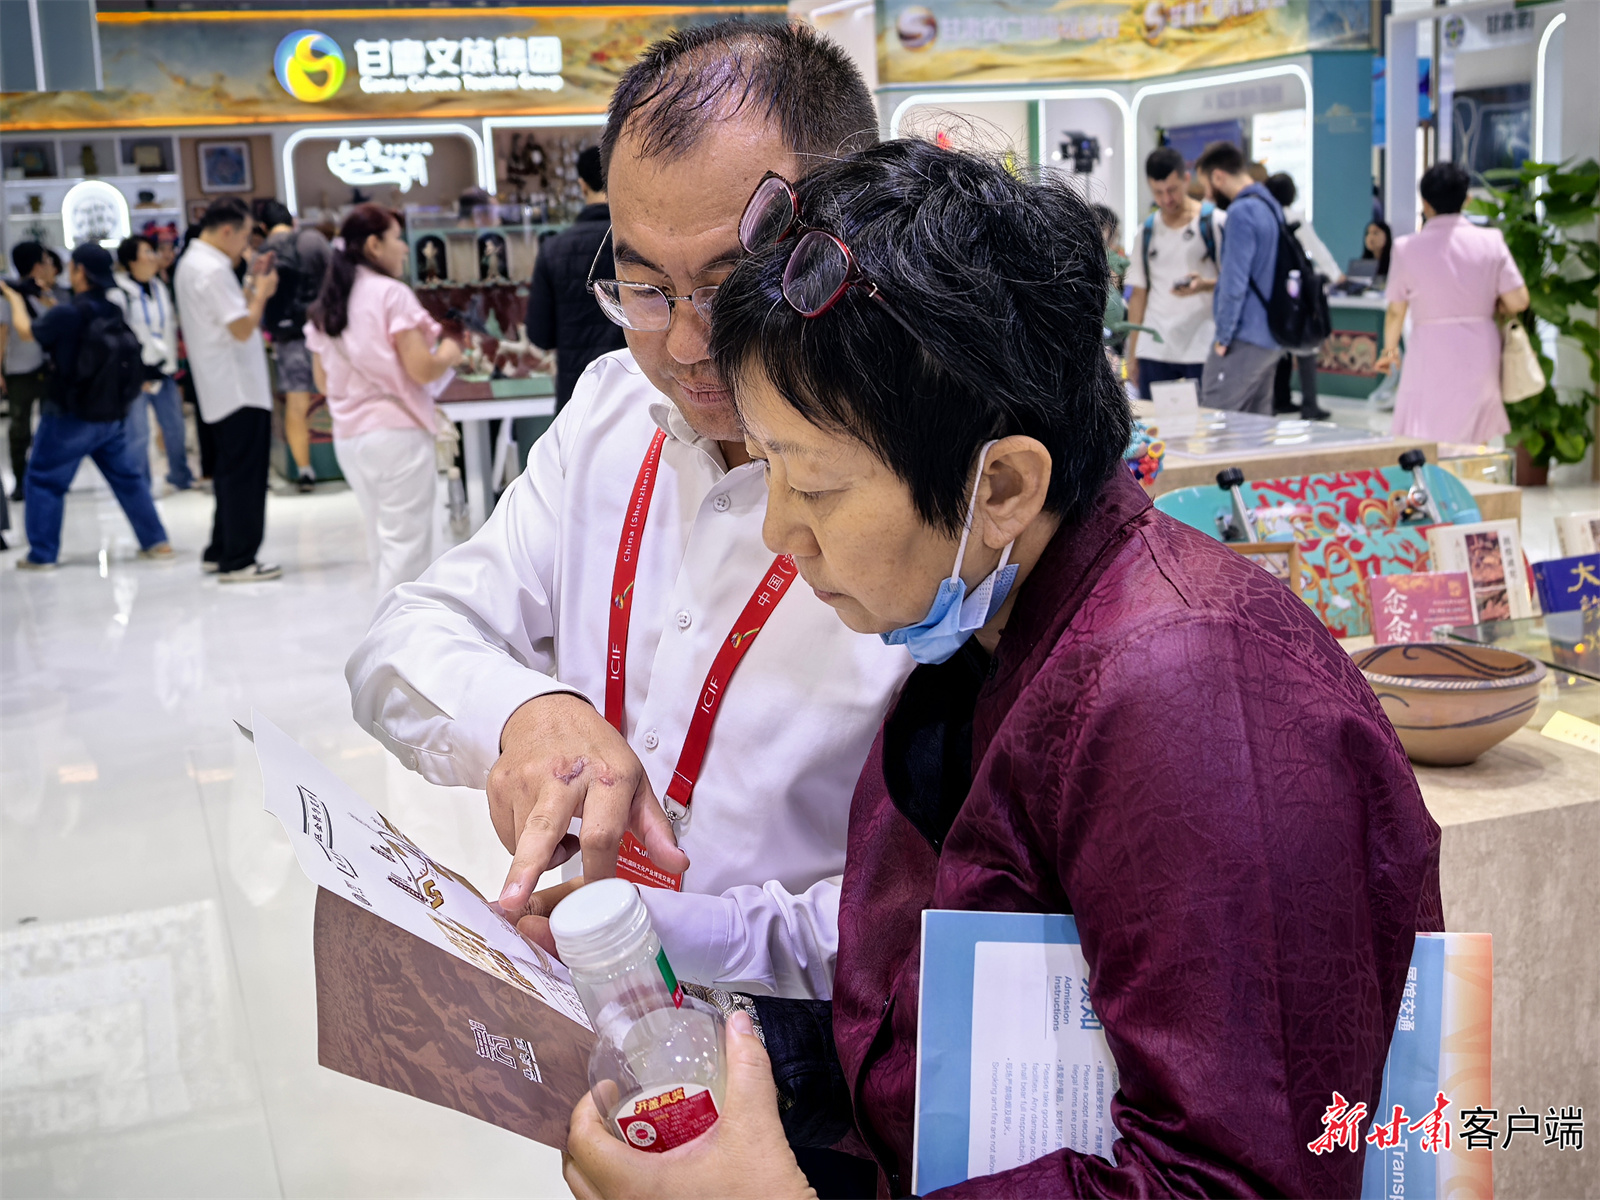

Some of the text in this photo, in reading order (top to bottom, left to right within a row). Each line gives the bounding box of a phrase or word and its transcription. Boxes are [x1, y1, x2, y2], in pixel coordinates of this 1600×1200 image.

[622, 530, 631, 562] China
[630, 467, 652, 530] (Shenzhen)
[609, 643, 620, 680] ICIF
[701, 675, 719, 714] ICIF
[1053, 975, 1062, 1031] Instructions
[1063, 976, 1072, 1025] Admission
[990, 1061, 999, 1094] Smoking
[1071, 1064, 1079, 1086] illegal
[1082, 1064, 1091, 1090] Please
[634, 1087, 686, 1115] 开盖赢奖
[1030, 1096, 1038, 1113] Any
[1071, 1087, 1079, 1107] items
[1029, 1113, 1037, 1145] damage
[1041, 1109, 1049, 1128] good
[1080, 1121, 1089, 1149] security
